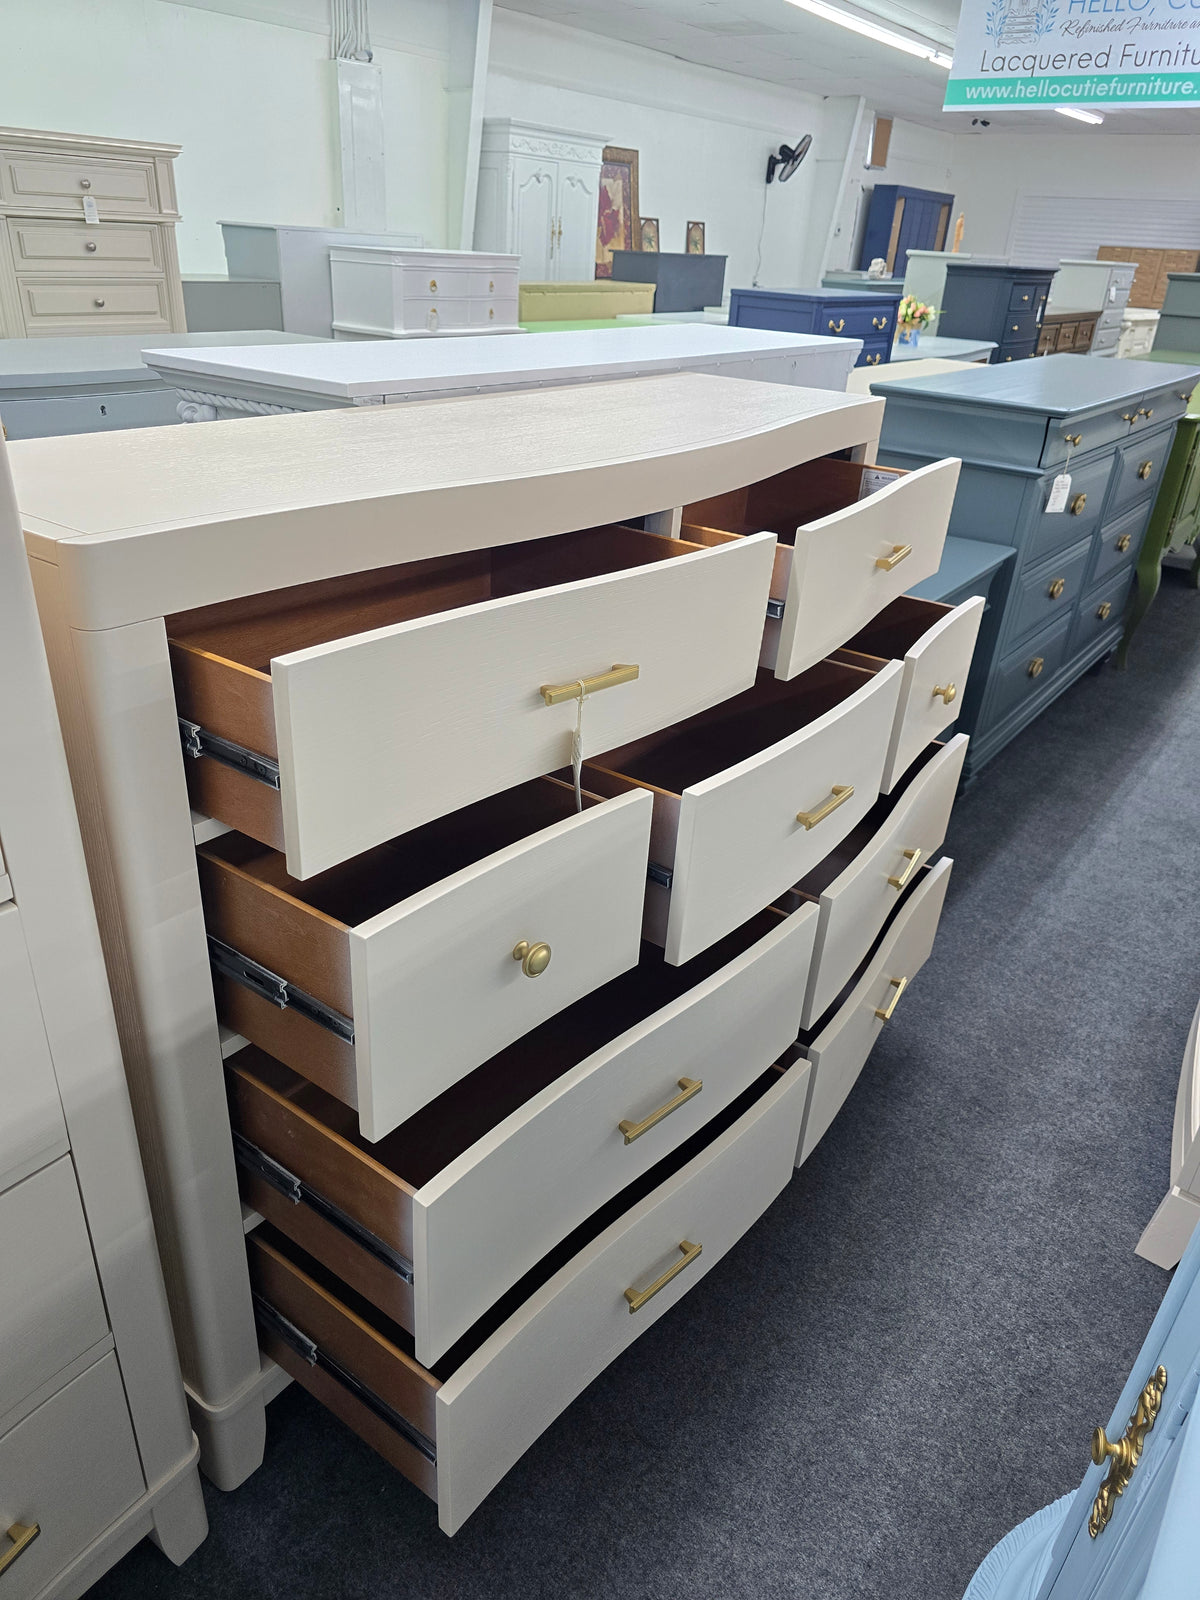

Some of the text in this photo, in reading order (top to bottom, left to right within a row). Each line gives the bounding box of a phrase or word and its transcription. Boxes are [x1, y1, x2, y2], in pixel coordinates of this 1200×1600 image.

[1060, 18, 1125, 39] Refinished
[1126, 17, 1188, 34] Furniture
[981, 45, 1112, 78] Lacquered
